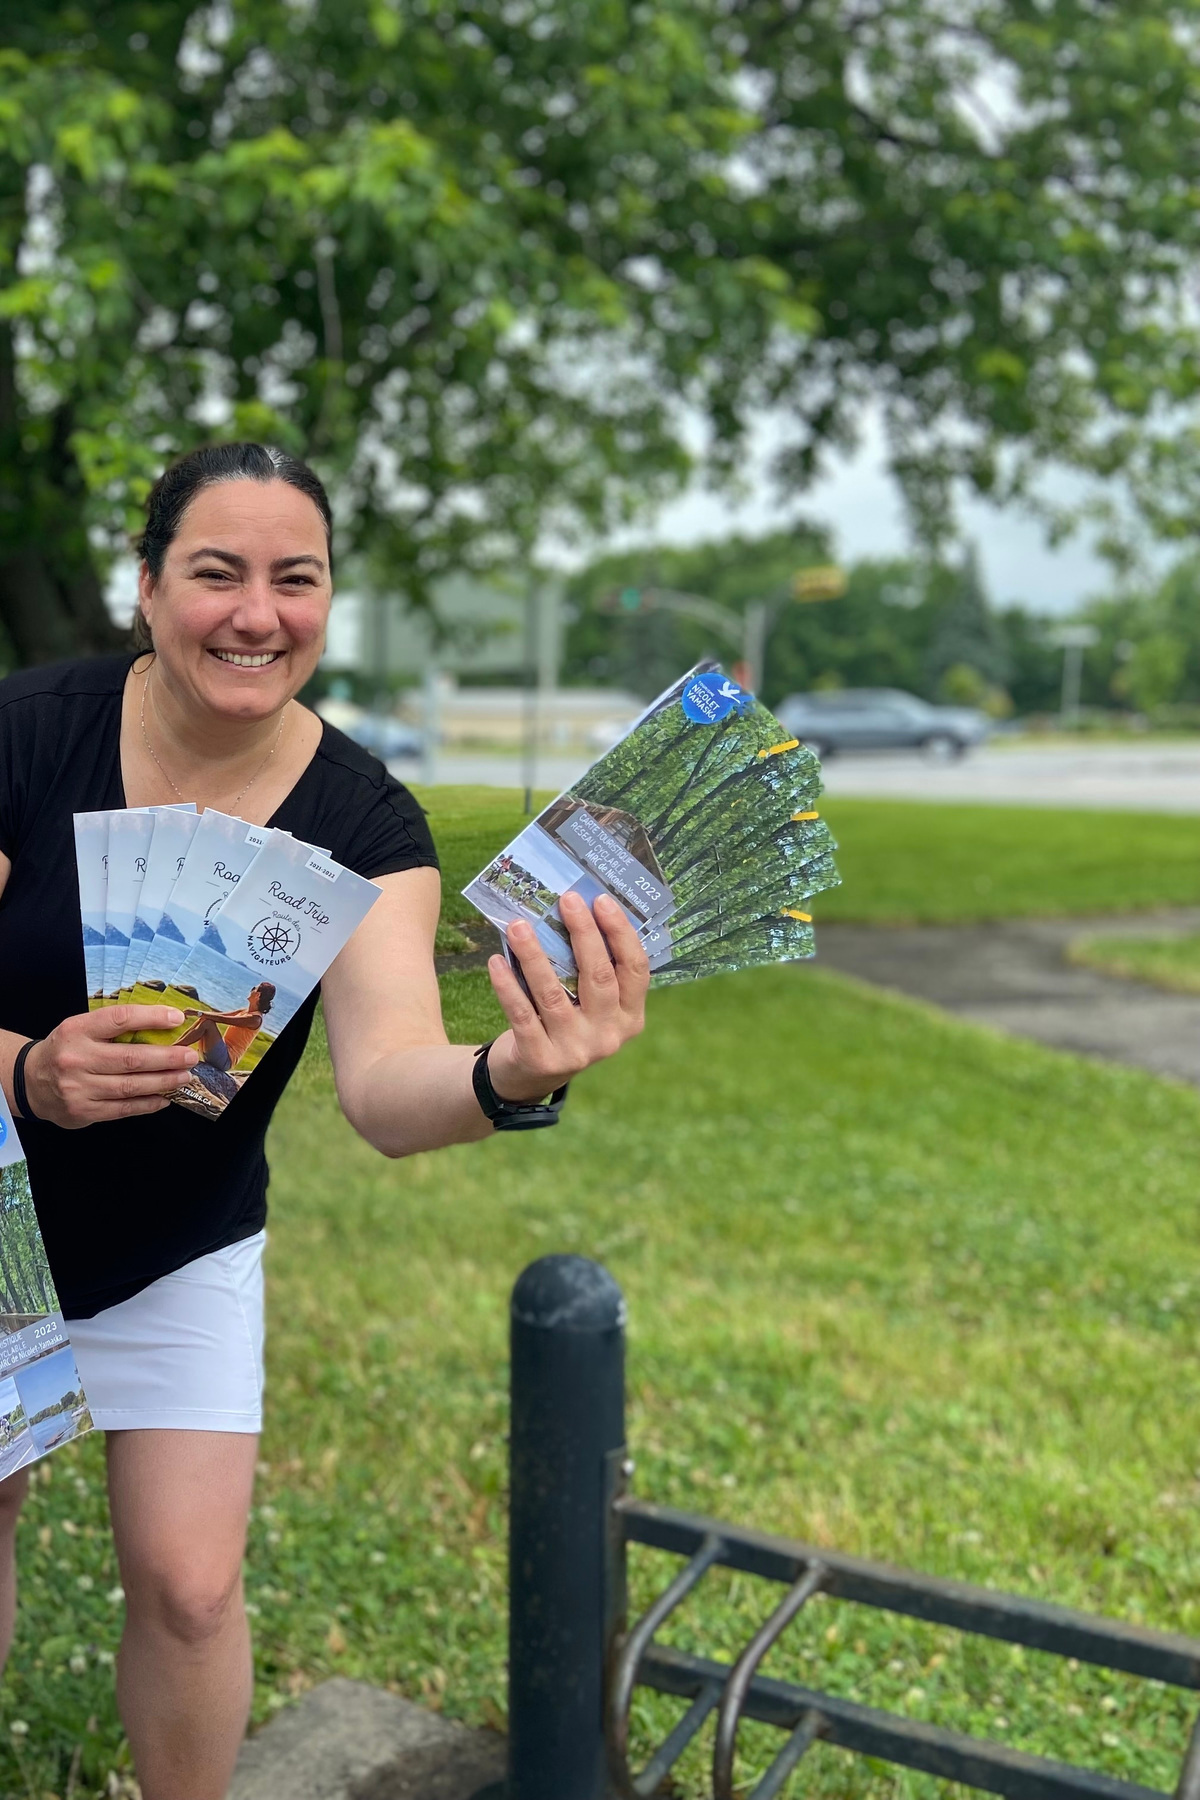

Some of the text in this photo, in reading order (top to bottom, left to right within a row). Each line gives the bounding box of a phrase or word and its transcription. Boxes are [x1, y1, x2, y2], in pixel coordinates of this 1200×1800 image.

[686, 690, 717, 721] YAMASKA
[692, 684, 720, 711] NICOLET
[570, 821, 626, 876] RÉSEAU CYCLABLE
[580, 813, 634, 866] CARTE TOURISTIQUE
[214, 862, 241, 882] Roa
[309, 862, 335, 879] 2021-2022
[585, 850, 650, 913] MRC de Nicolet-Yamaska
[635, 876, 661, 901] 2023
[268, 881, 330, 926] Road Trip
[272, 911, 301, 932] Route des
[247, 935, 291, 966] NAVIGATEURS
[179, 1087, 212, 1106] ATEURS.CA
[34, 1321, 58, 1338] 2023
[11, 1356, 19, 1364] de
[18, 1334, 63, 1361] Nicolet-Yamaska
